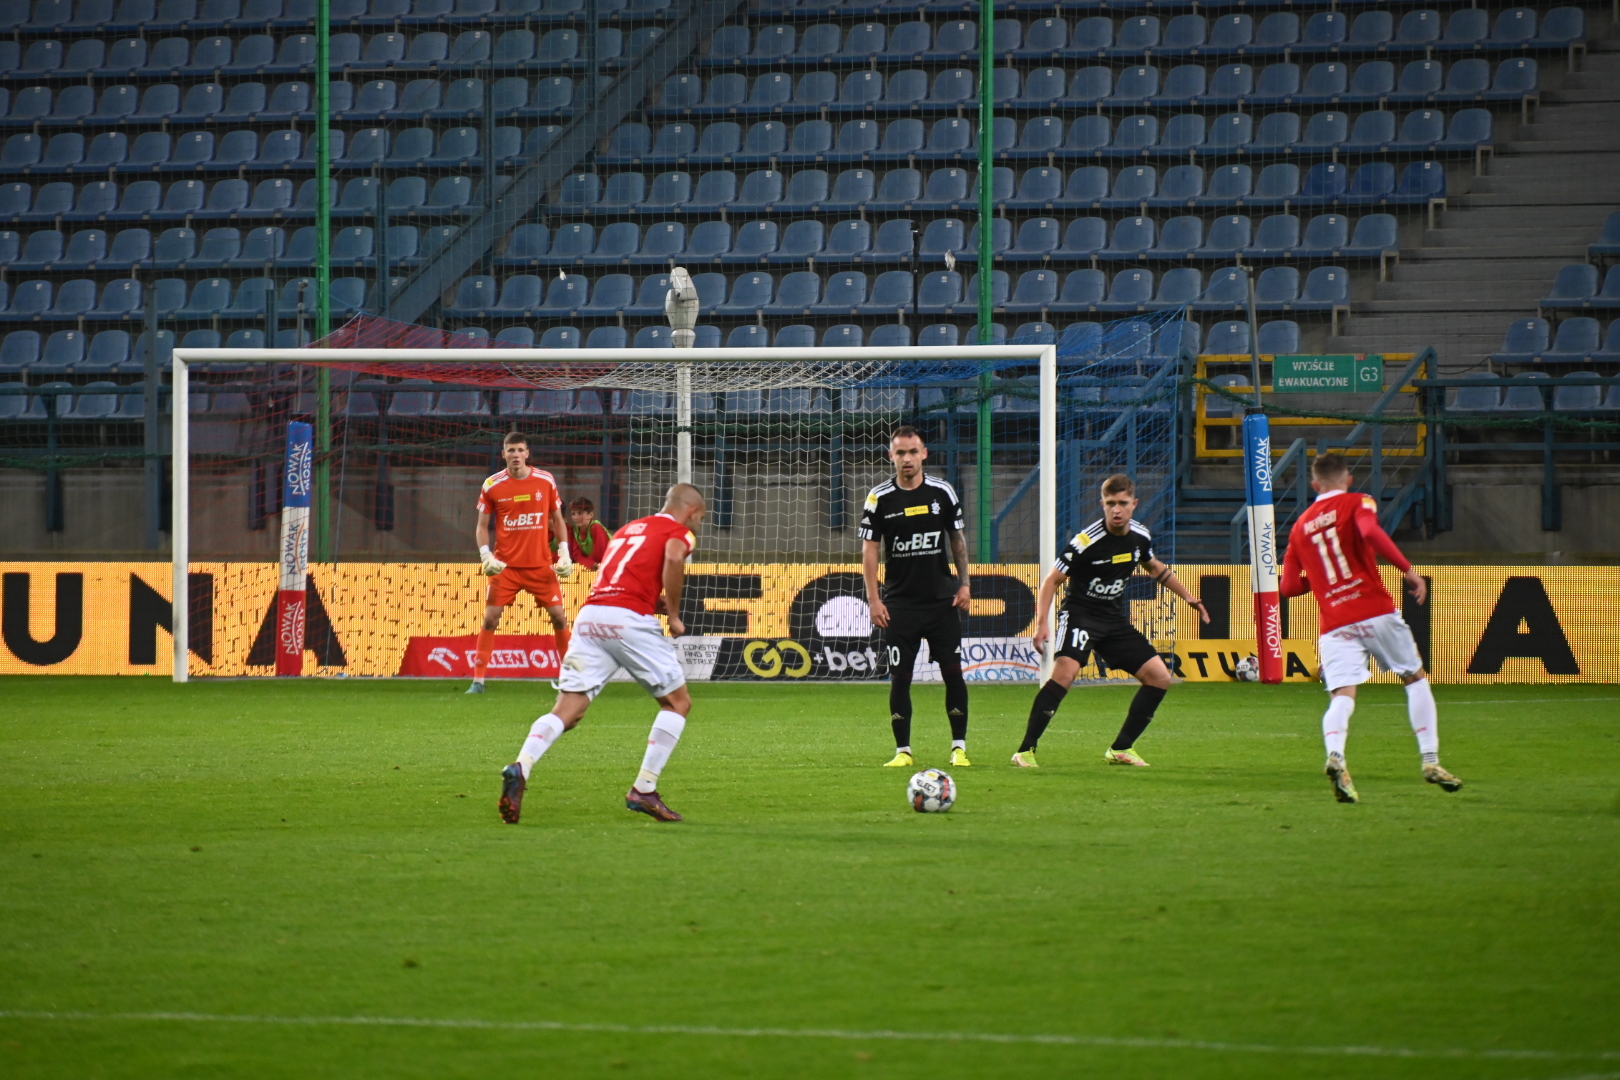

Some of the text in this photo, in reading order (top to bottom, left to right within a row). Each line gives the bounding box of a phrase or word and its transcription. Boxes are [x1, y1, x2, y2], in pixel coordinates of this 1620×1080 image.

[1279, 377, 1349, 387] EWAKUACYJNE
[1293, 359, 1335, 371] WYJŚCIE
[1360, 367, 1379, 382] G3
[288, 443, 304, 495] NOWAK
[303, 449, 312, 490] MOSTY
[1255, 437, 1272, 492] NOWAK
[503, 512, 544, 527] forBET
[892, 531, 942, 552] forBET
[285, 524, 300, 575] NOWAK
[595, 535, 647, 588] 77
[1261, 522, 1276, 575] NOWAK
[1311, 527, 1353, 585] 11
[281, 602, 298, 654] NOWAK
[1072, 628, 1089, 651] 19
[1266, 604, 1282, 658] NOWAK
[887, 645, 900, 666] 10
